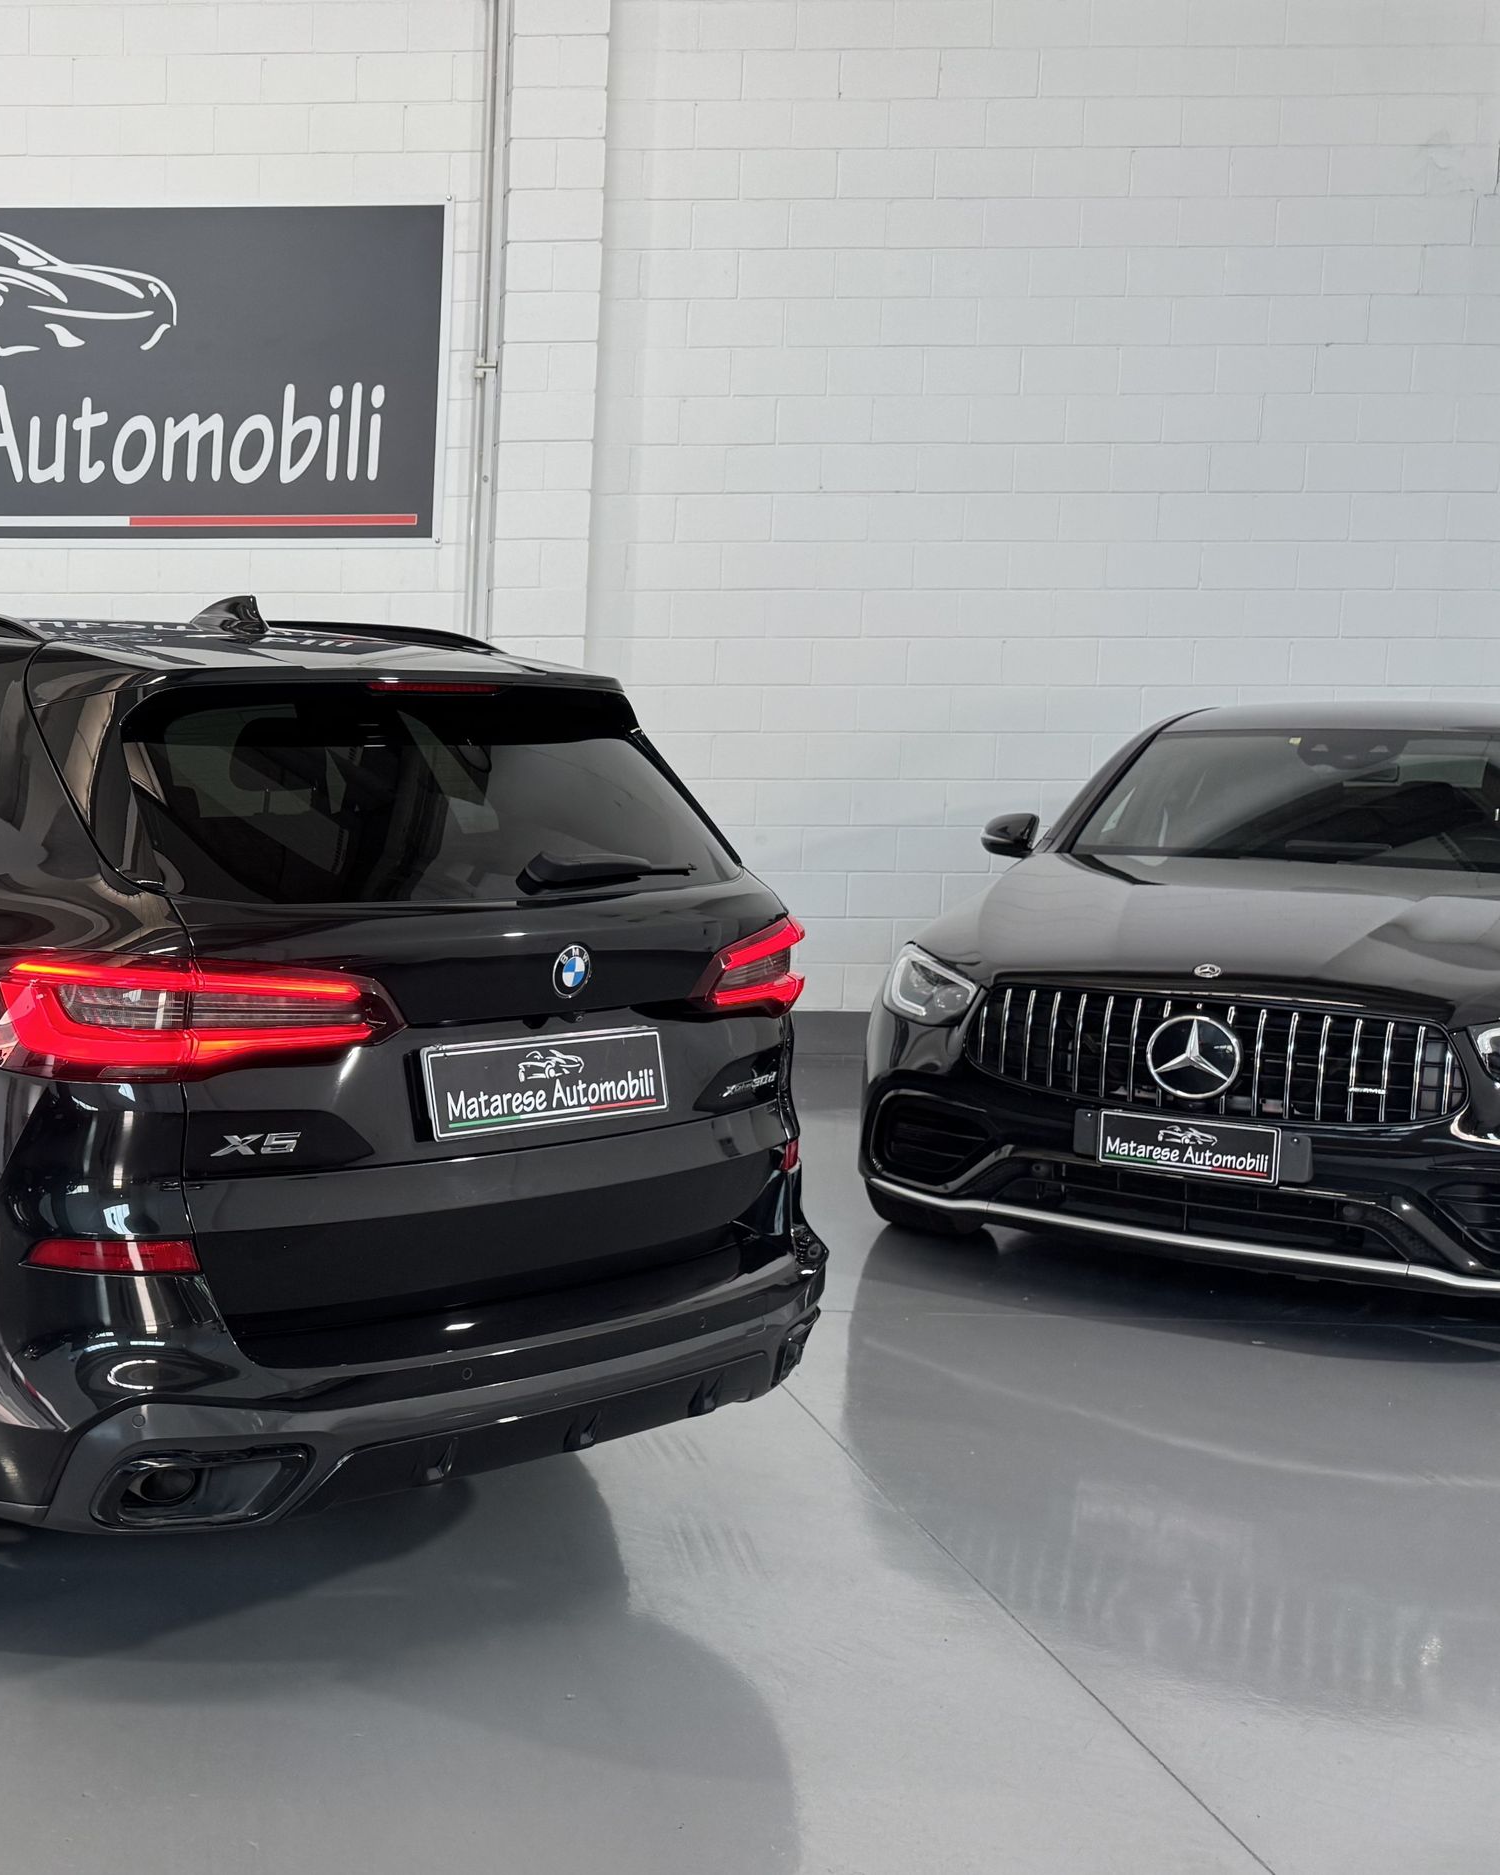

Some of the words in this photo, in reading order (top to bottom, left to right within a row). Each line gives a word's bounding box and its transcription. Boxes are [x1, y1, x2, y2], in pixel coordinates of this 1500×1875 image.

[560, 947, 589, 964] BMW
[446, 1087, 548, 1122] Matarese
[552, 1068, 656, 1109] Automobili
[209, 1131, 302, 1157] X5
[1105, 1135, 1180, 1162] Matarese
[1183, 1145, 1269, 1173] Automobili
